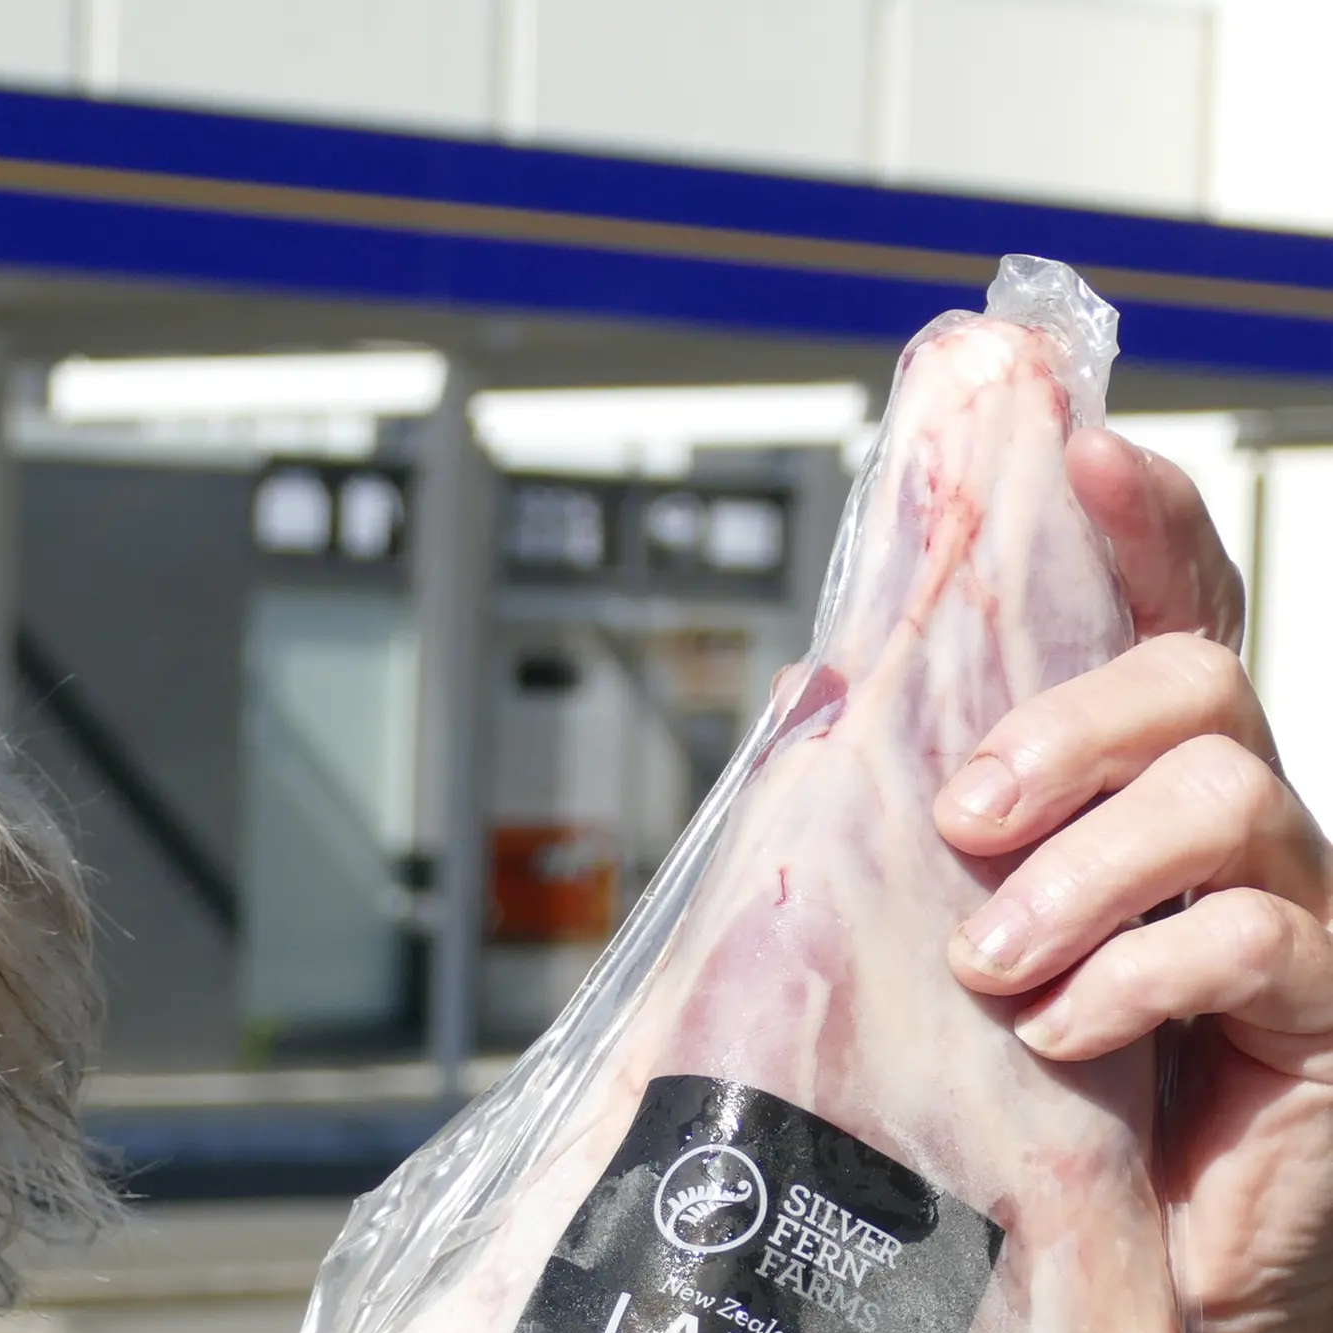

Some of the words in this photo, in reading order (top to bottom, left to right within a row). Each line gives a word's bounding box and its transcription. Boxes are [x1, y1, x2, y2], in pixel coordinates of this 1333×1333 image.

[767, 1213, 872, 1289] FERN
[783, 1183, 902, 1270] SILVER
[658, 1277, 716, 1310] New
[754, 1245, 882, 1333] FARMS
